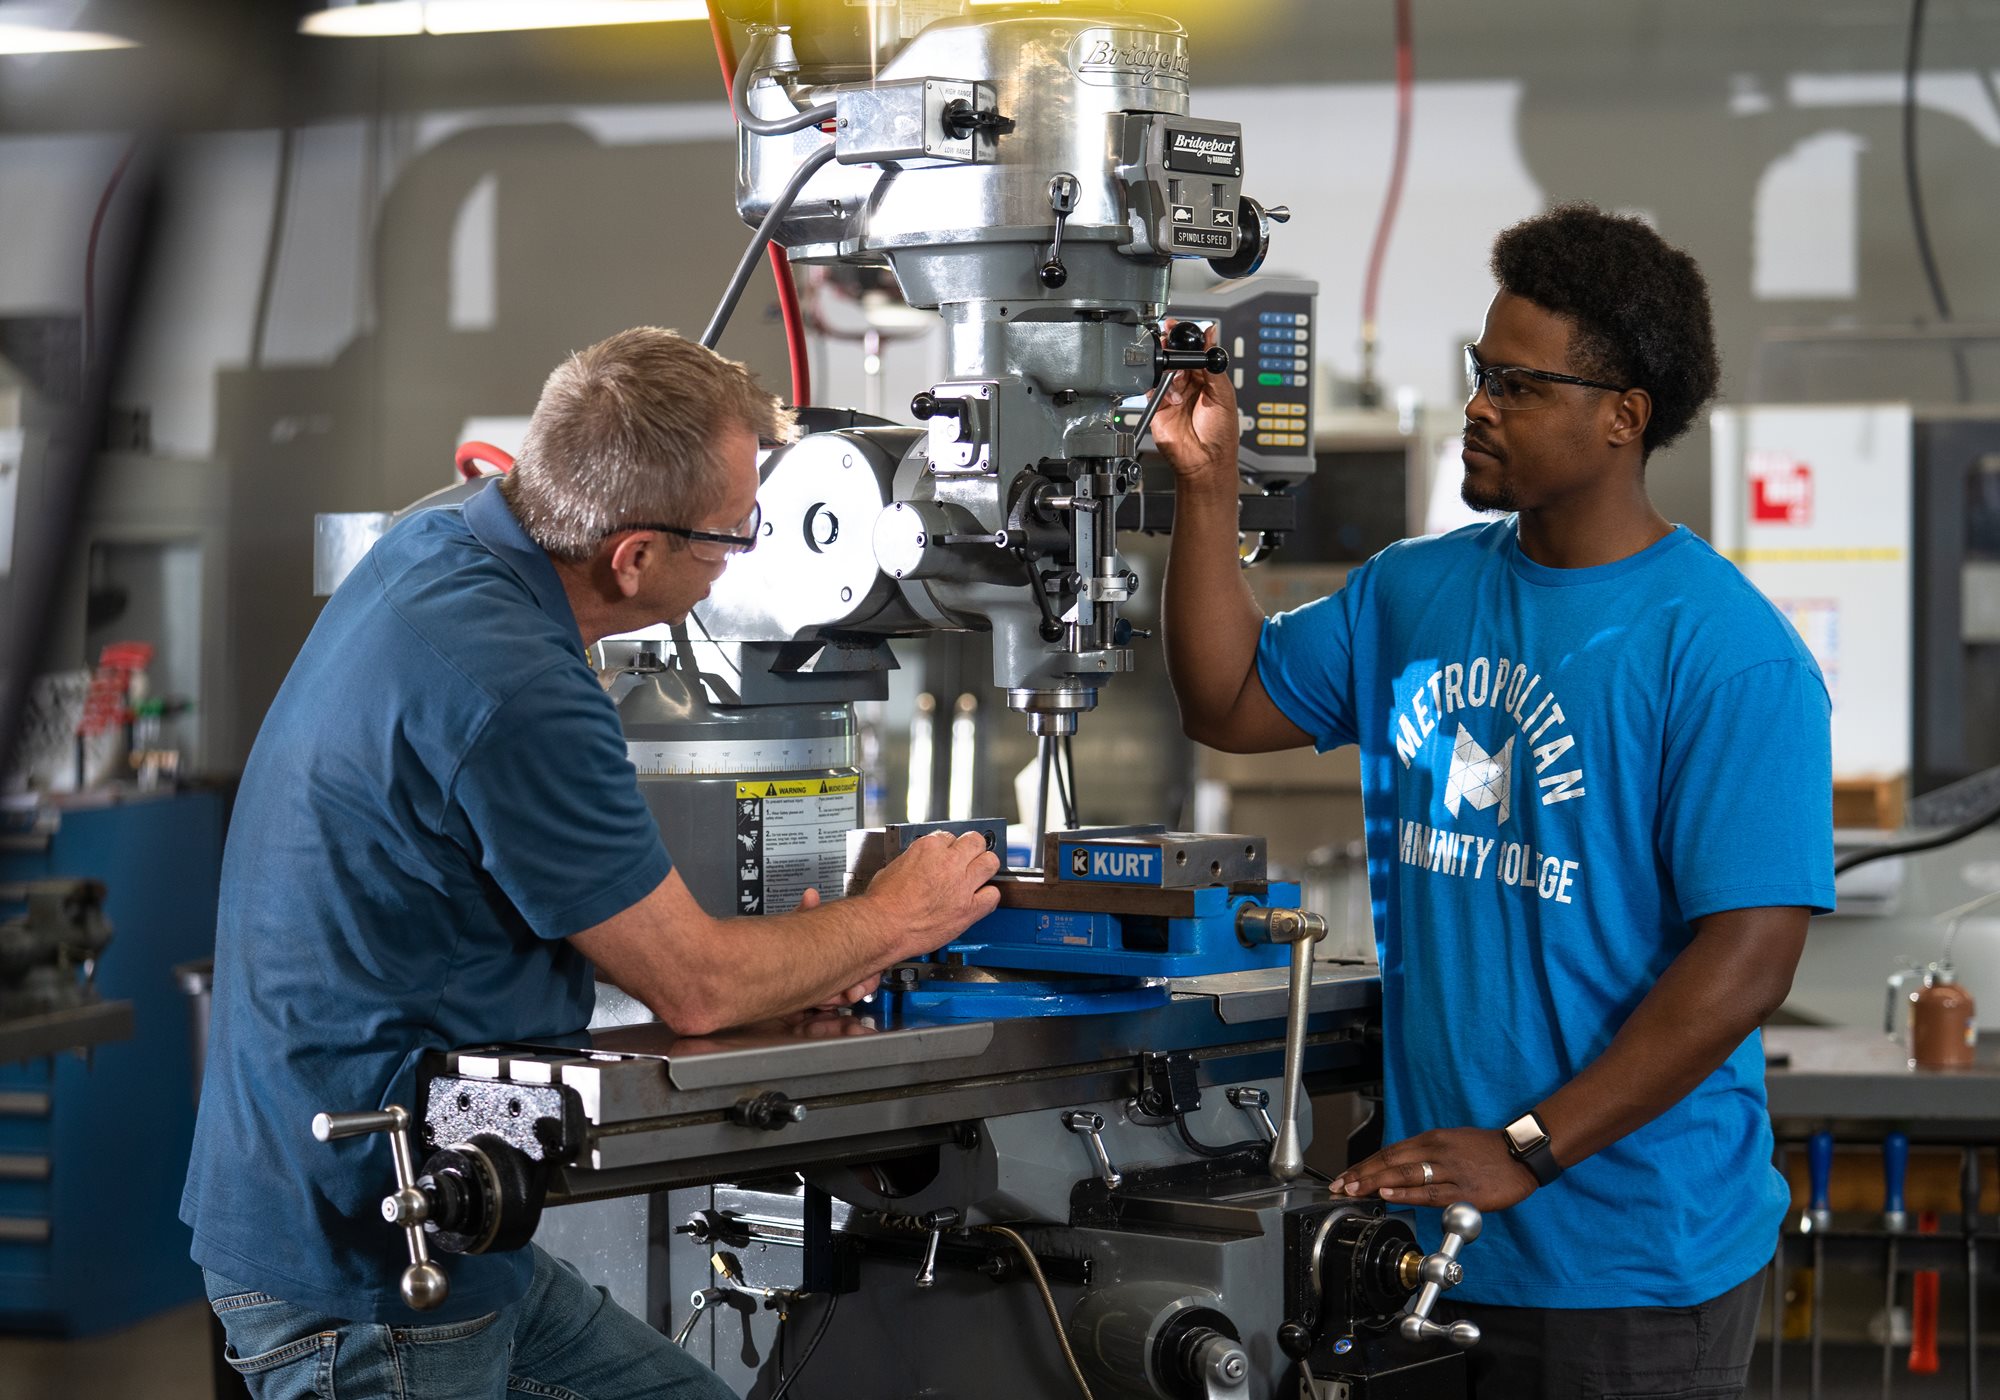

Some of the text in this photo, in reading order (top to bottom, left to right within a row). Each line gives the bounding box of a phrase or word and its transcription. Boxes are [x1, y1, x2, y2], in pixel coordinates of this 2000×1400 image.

[957, 89, 972, 98] RANGE
[944, 146, 954, 154] LOW
[956, 148, 971, 156] RANGE
[1174, 134, 1236, 158] Bridgeport
[1207, 155, 1213, 165] by
[1178, 232, 1228, 247] SPINDLE SPEED
[1396, 656, 1586, 806] METROPOLITAN
[779, 787, 807, 795] WARNING
[1094, 851, 1154, 878] KURT
